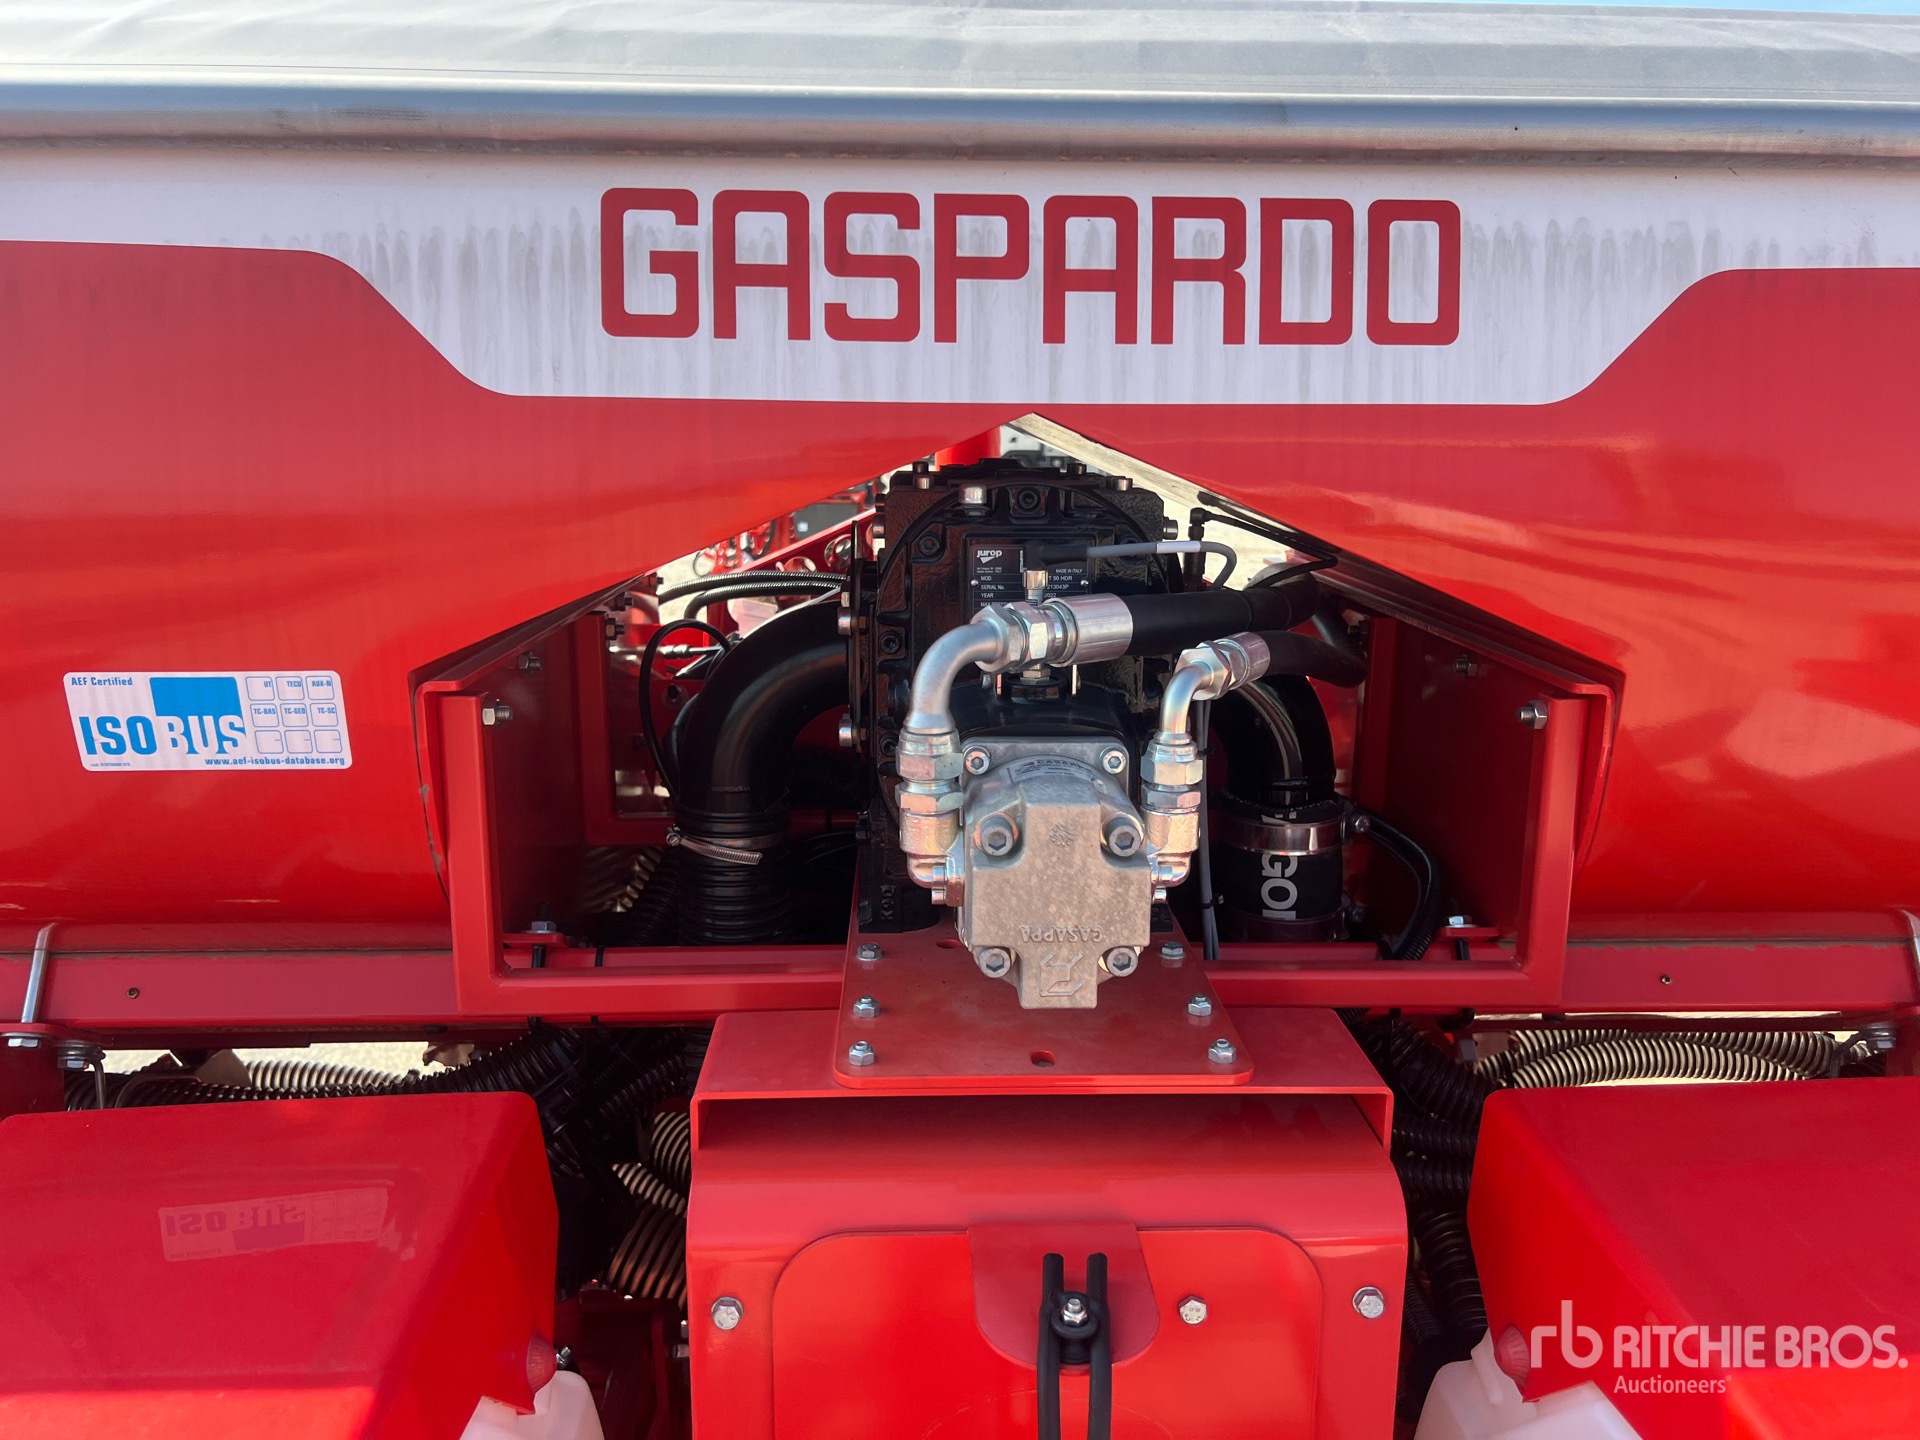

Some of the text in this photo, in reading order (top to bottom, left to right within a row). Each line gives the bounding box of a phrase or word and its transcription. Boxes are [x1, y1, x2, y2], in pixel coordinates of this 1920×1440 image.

[600, 188, 1460, 346] GASPARDO
[977, 550, 1002, 558] jurop
[71, 676, 133, 686] AEF Certified
[79, 715, 246, 755] ISOBUS
[205, 756, 345, 766] www.aef-isobus-database.org
[1019, 924, 1103, 944] CASAPPA
